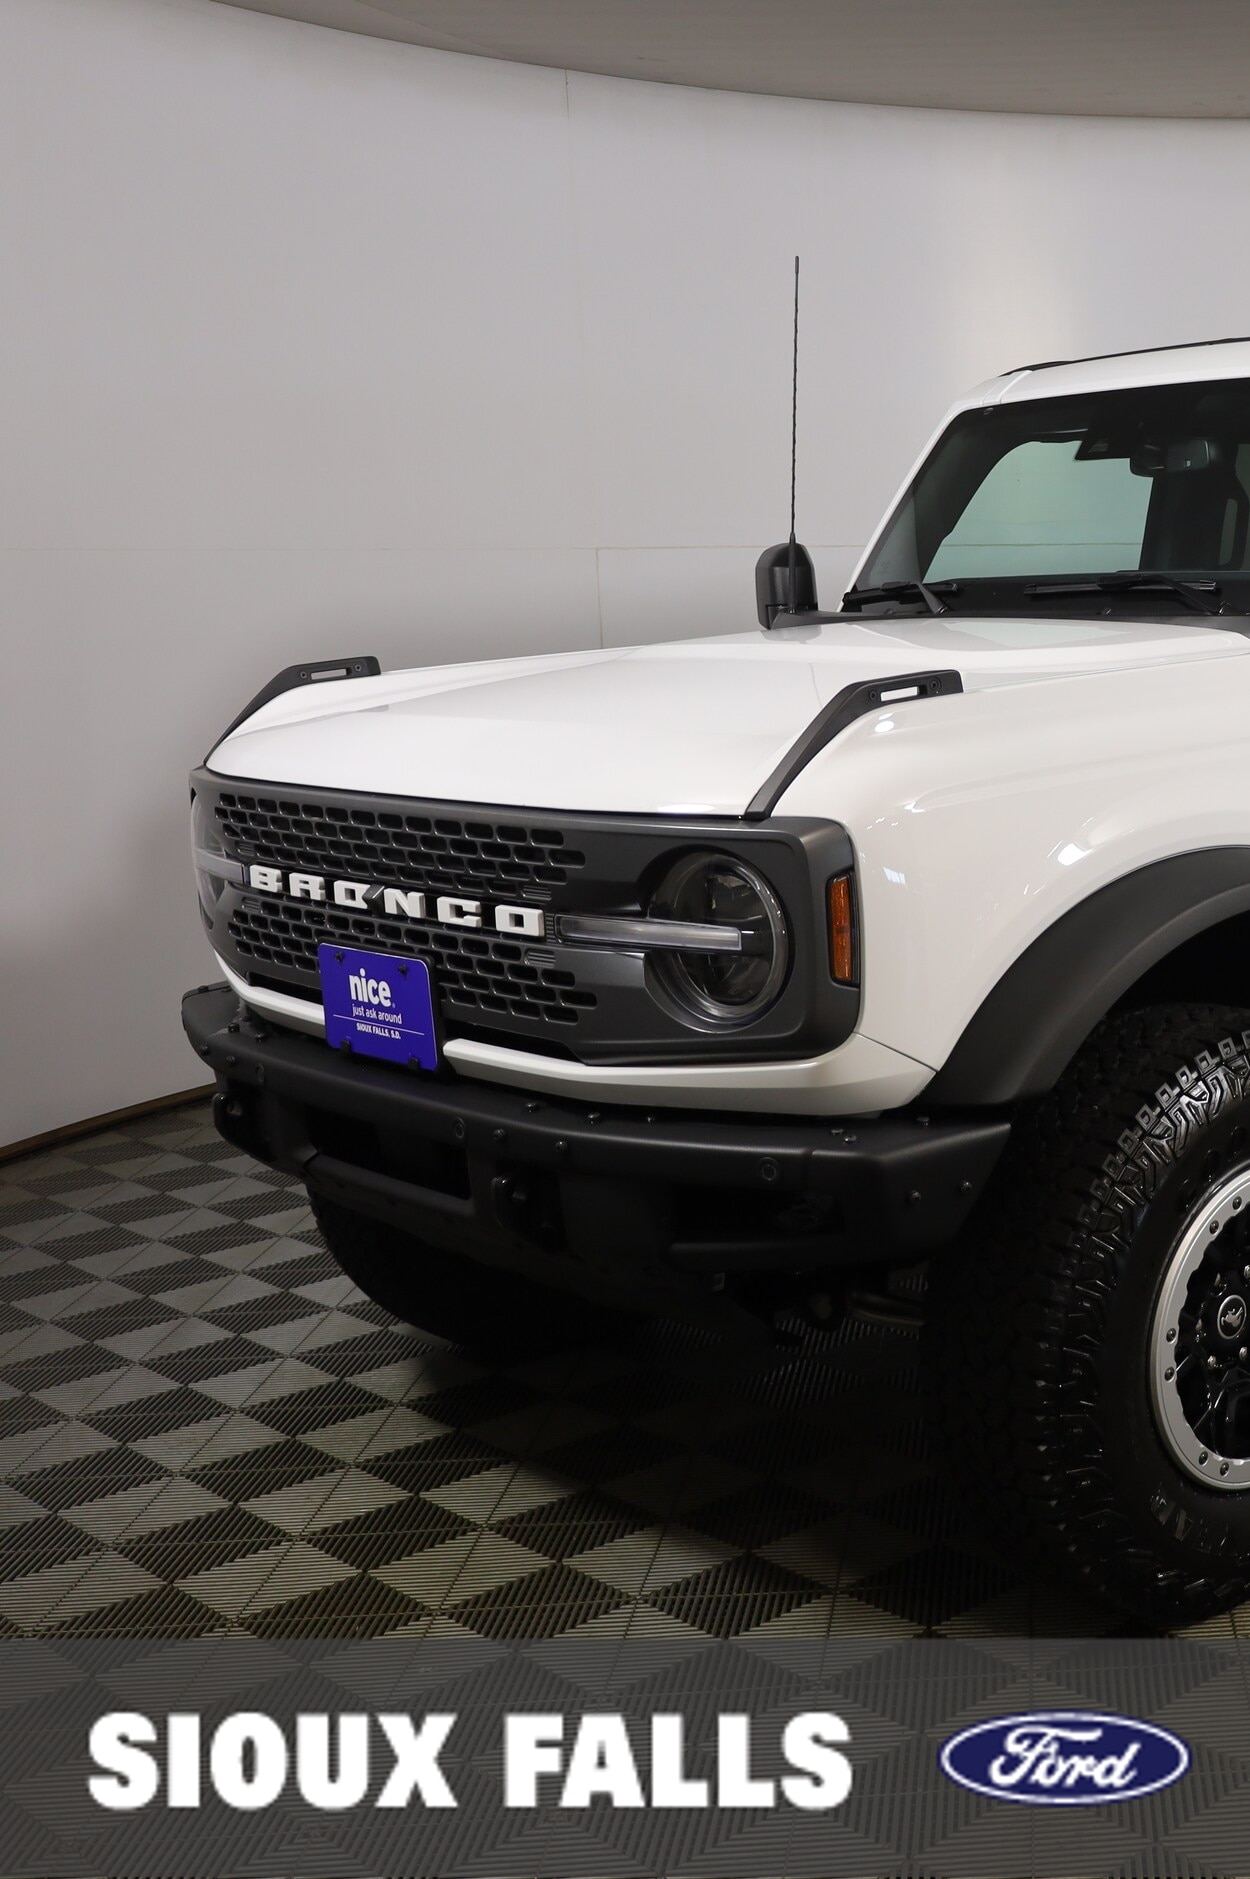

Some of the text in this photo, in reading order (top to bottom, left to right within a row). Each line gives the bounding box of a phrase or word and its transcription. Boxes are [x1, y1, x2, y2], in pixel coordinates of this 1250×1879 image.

[249, 865, 546, 937] BRONCO
[349, 968, 391, 1007] nice
[352, 1003, 402, 1024] just ask around
[356, 1022, 372, 1033] SIOUX
